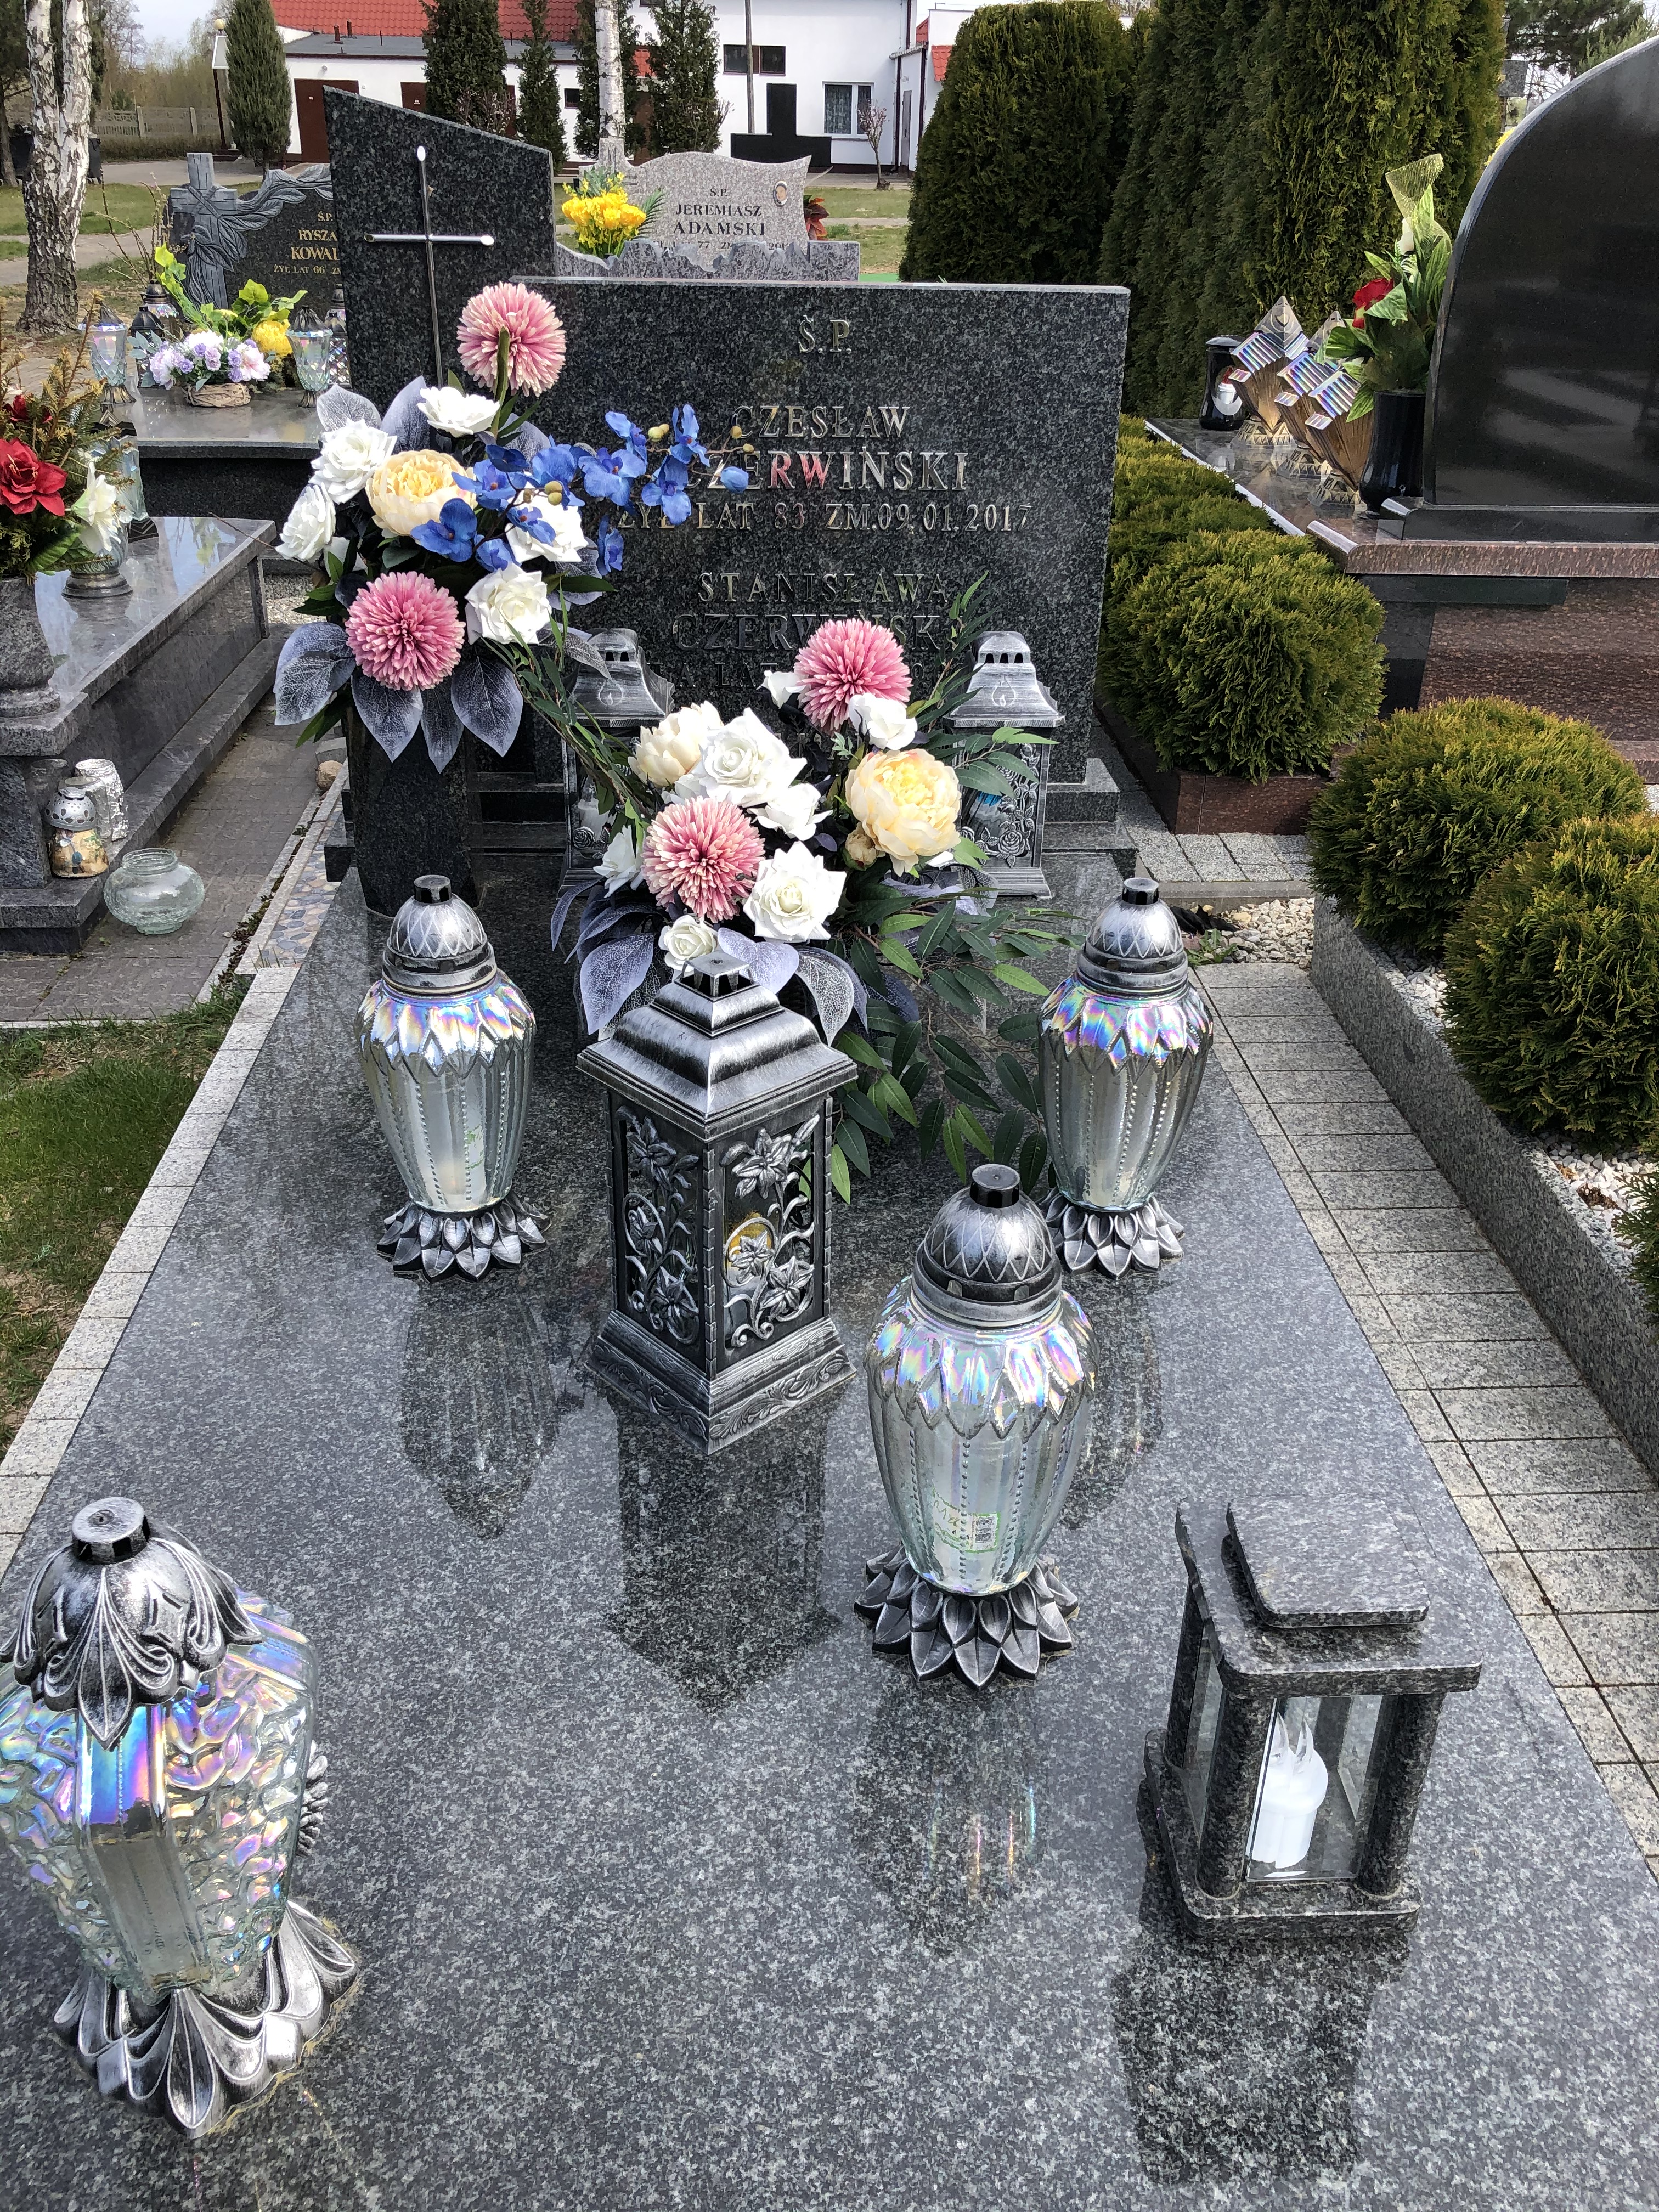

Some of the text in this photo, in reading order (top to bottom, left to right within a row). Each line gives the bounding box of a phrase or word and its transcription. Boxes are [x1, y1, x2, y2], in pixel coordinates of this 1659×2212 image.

[318, 211, 334, 222] Ś.P.
[676, 204, 762, 217] JEREMIASZ
[673, 221, 765, 236] ADAMSKI
[313, 266, 325, 274] 66
[798, 314, 852, 354] Ś.P.
[731, 405, 910, 438] CZESŁAW
[685, 446, 968, 491] ZERWIŃSKI
[696, 502, 755, 530] LAT
[774, 502, 805, 529] 83
[698, 572, 949, 603] STANISŁAWA
[715, 662, 777, 687] LA
